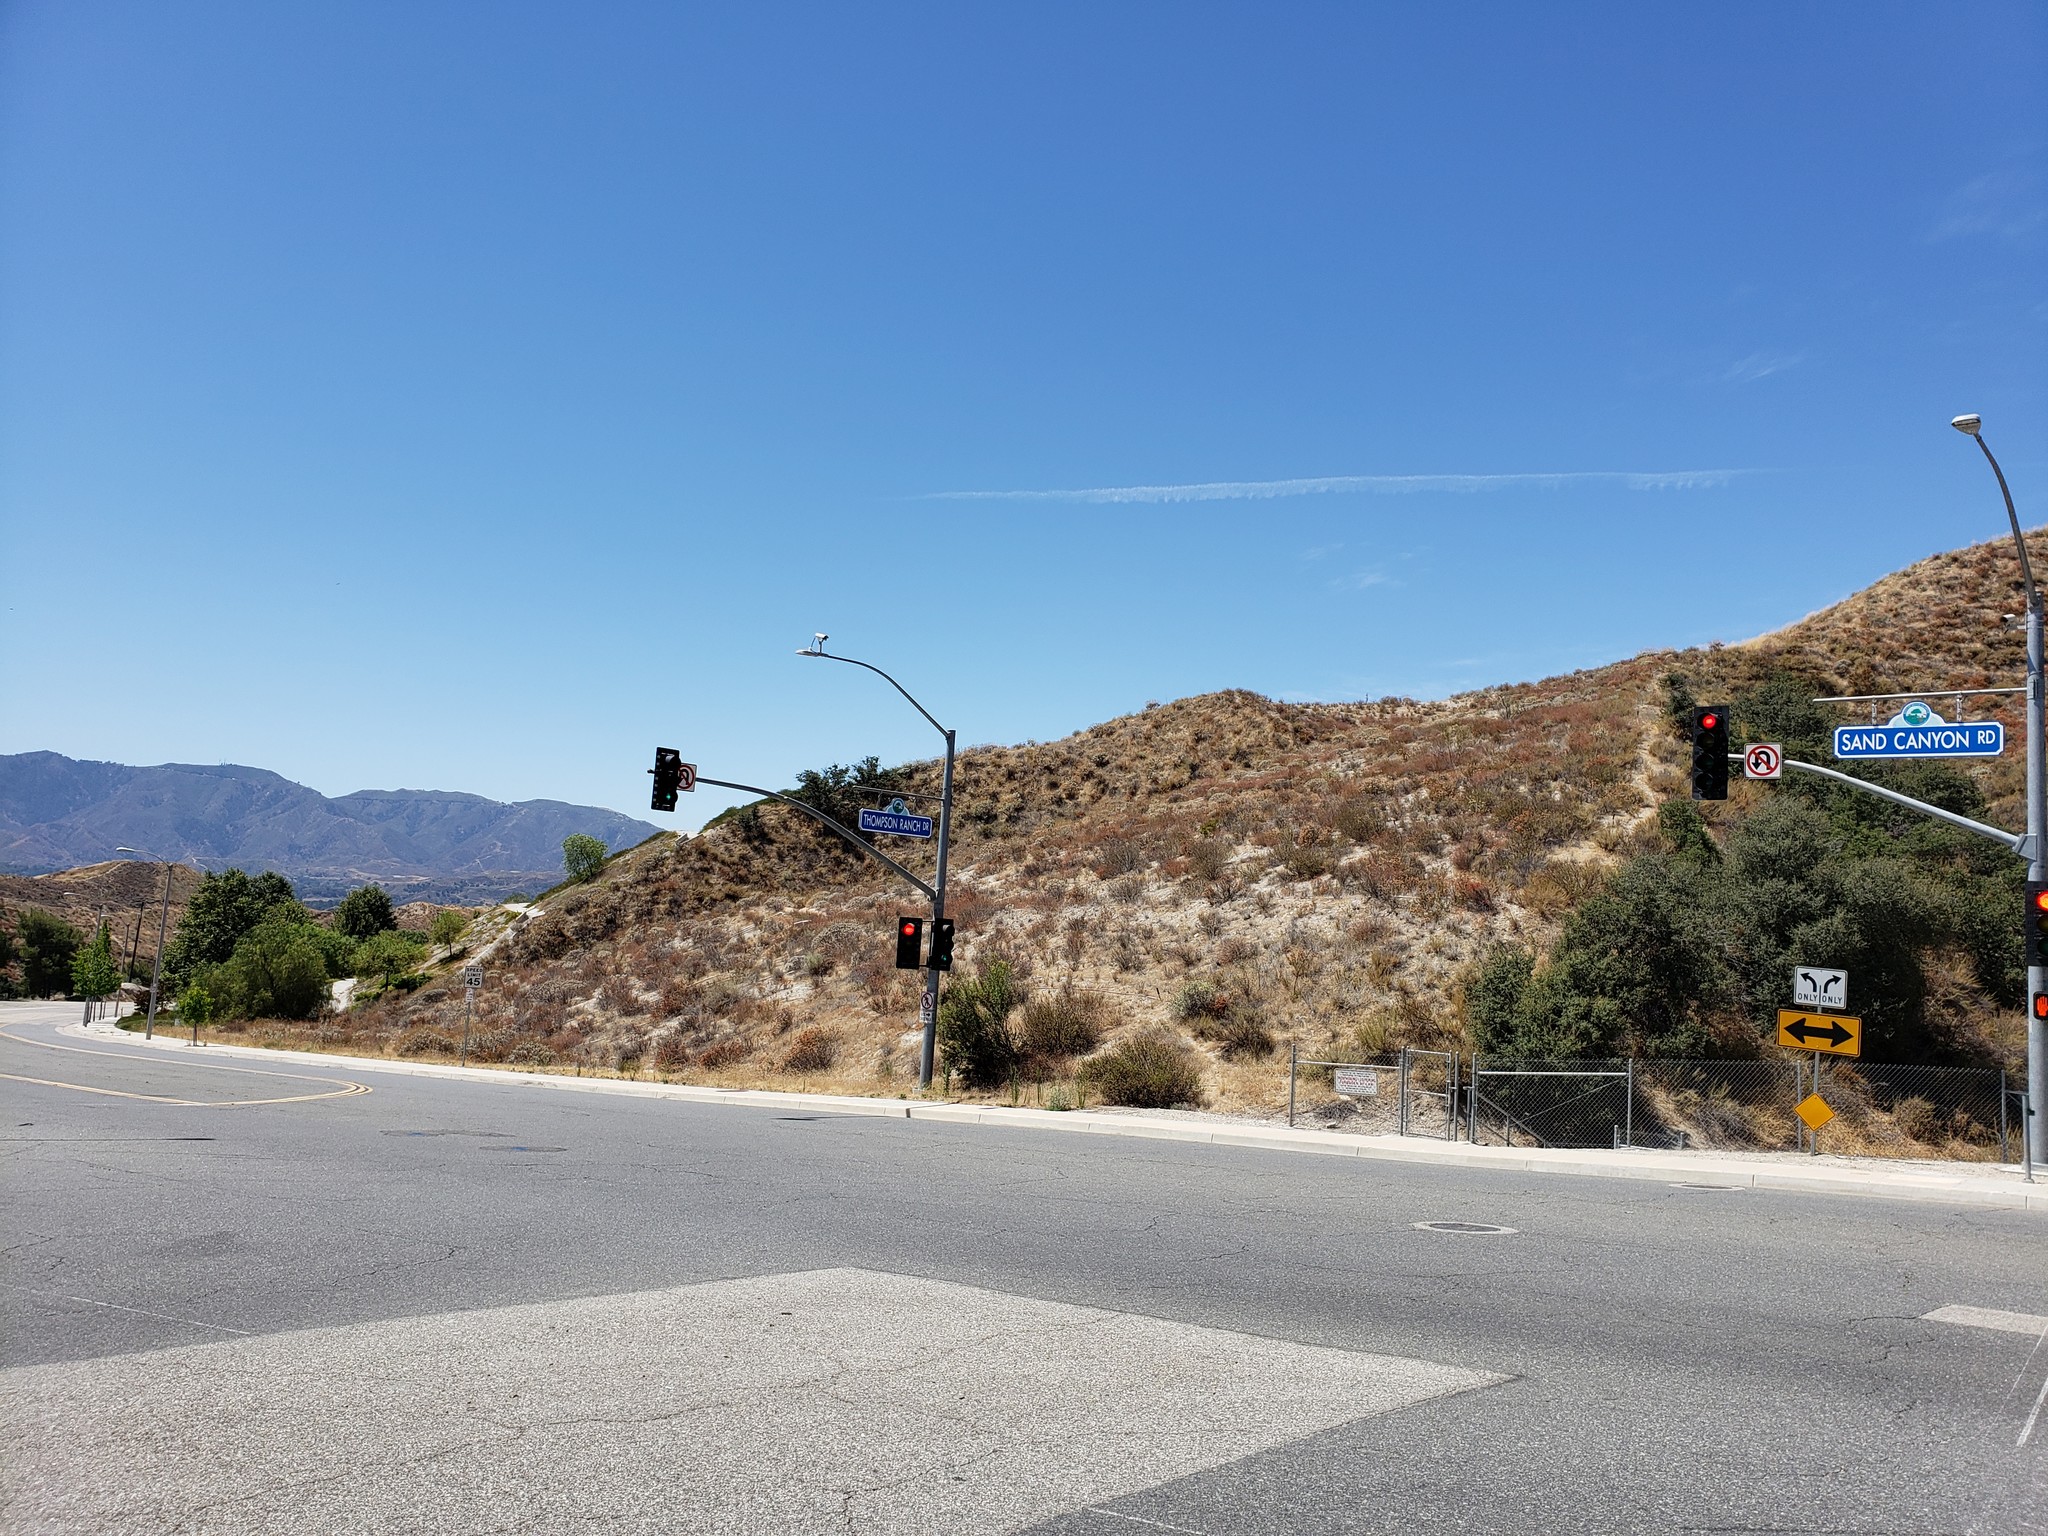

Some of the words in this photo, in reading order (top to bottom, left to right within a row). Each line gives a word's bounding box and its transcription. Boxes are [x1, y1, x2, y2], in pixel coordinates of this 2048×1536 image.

[1841, 733, 1887, 751] SAND
[1893, 730, 1970, 750] CANYON
[1977, 730, 1996, 745] RD
[863, 813, 898, 829] THOMPSON
[899, 818, 921, 832] RANCH
[922, 821, 929, 832] DR
[466, 977, 481, 986] 45
[1797, 992, 1818, 1002] ONLY
[1821, 994, 1843, 1005] ONLY
